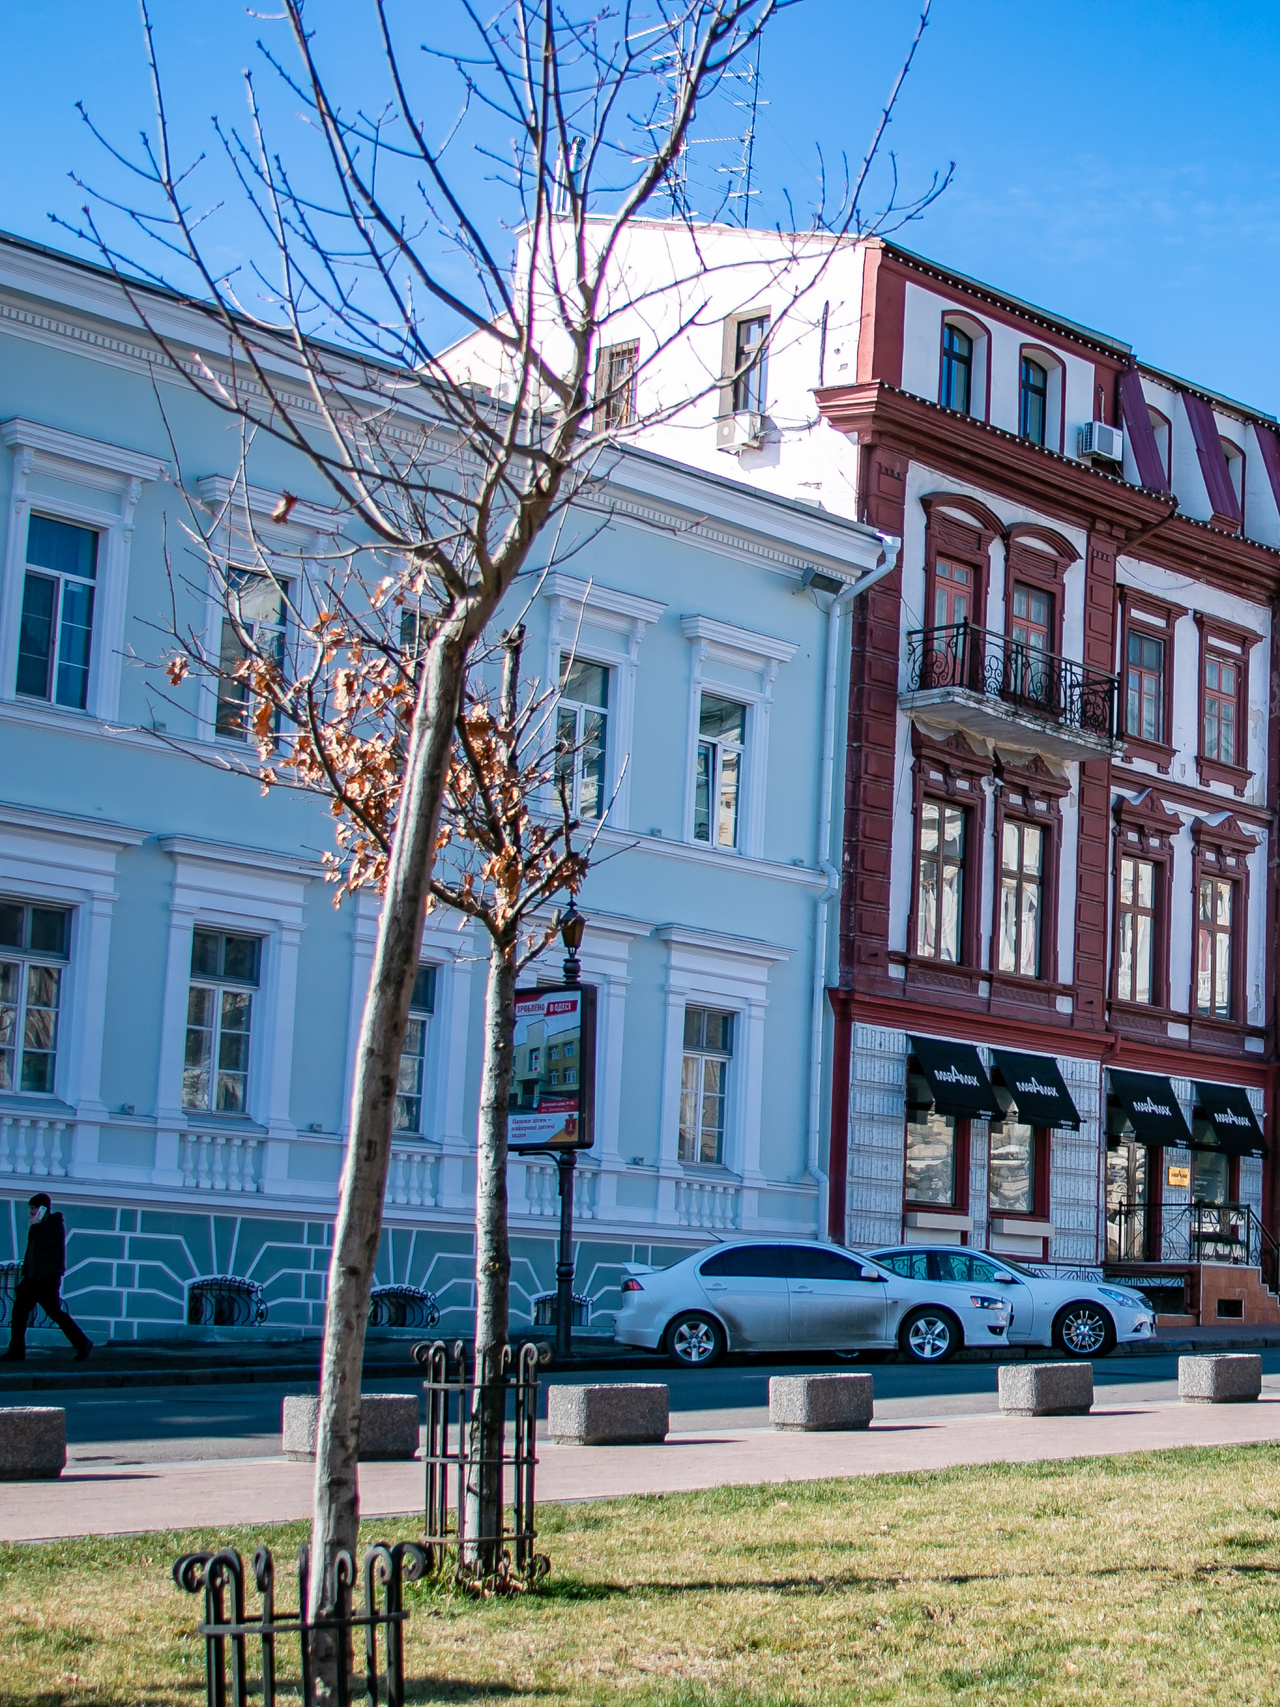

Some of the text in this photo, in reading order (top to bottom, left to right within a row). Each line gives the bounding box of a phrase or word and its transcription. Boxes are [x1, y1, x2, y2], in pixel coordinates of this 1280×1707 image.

[517, 1003, 545, 1013] ЗРОБЛЕНО
[555, 1002, 571, 1012] ОДЕСІ
[934, 1065, 980, 1087] MARAMAX
[1016, 1076, 1059, 1097] MARAMAX
[1133, 1096, 1172, 1116] MARAMAX
[1214, 1107, 1251, 1127] MARAMAX
